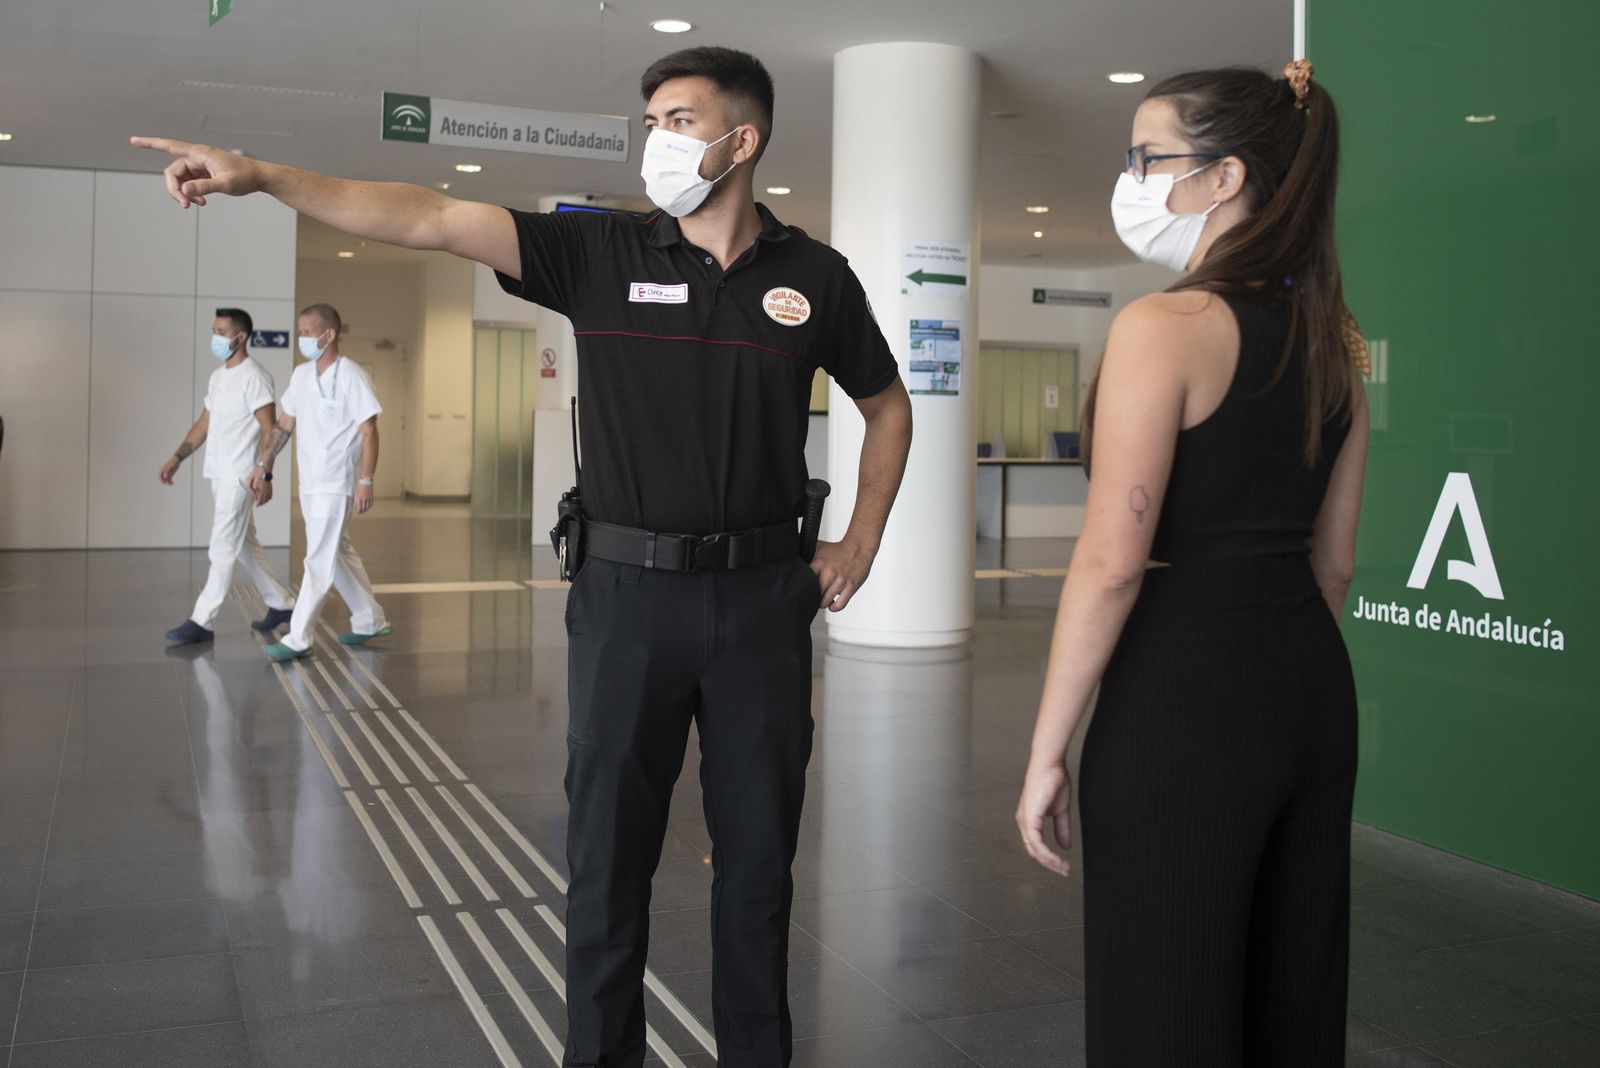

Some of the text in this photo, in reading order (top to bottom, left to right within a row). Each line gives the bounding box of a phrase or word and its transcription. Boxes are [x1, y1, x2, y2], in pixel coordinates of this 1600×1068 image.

[440, 116, 508, 140] Atención
[513, 128, 522, 142] a
[526, 125, 540, 144] la
[544, 126, 625, 152] Ciudadanía
[767, 302, 808, 317] SEGURIDAD
[769, 291, 806, 307] VIGILANTE
[1353, 595, 1565, 651] Junta de Andalucía
